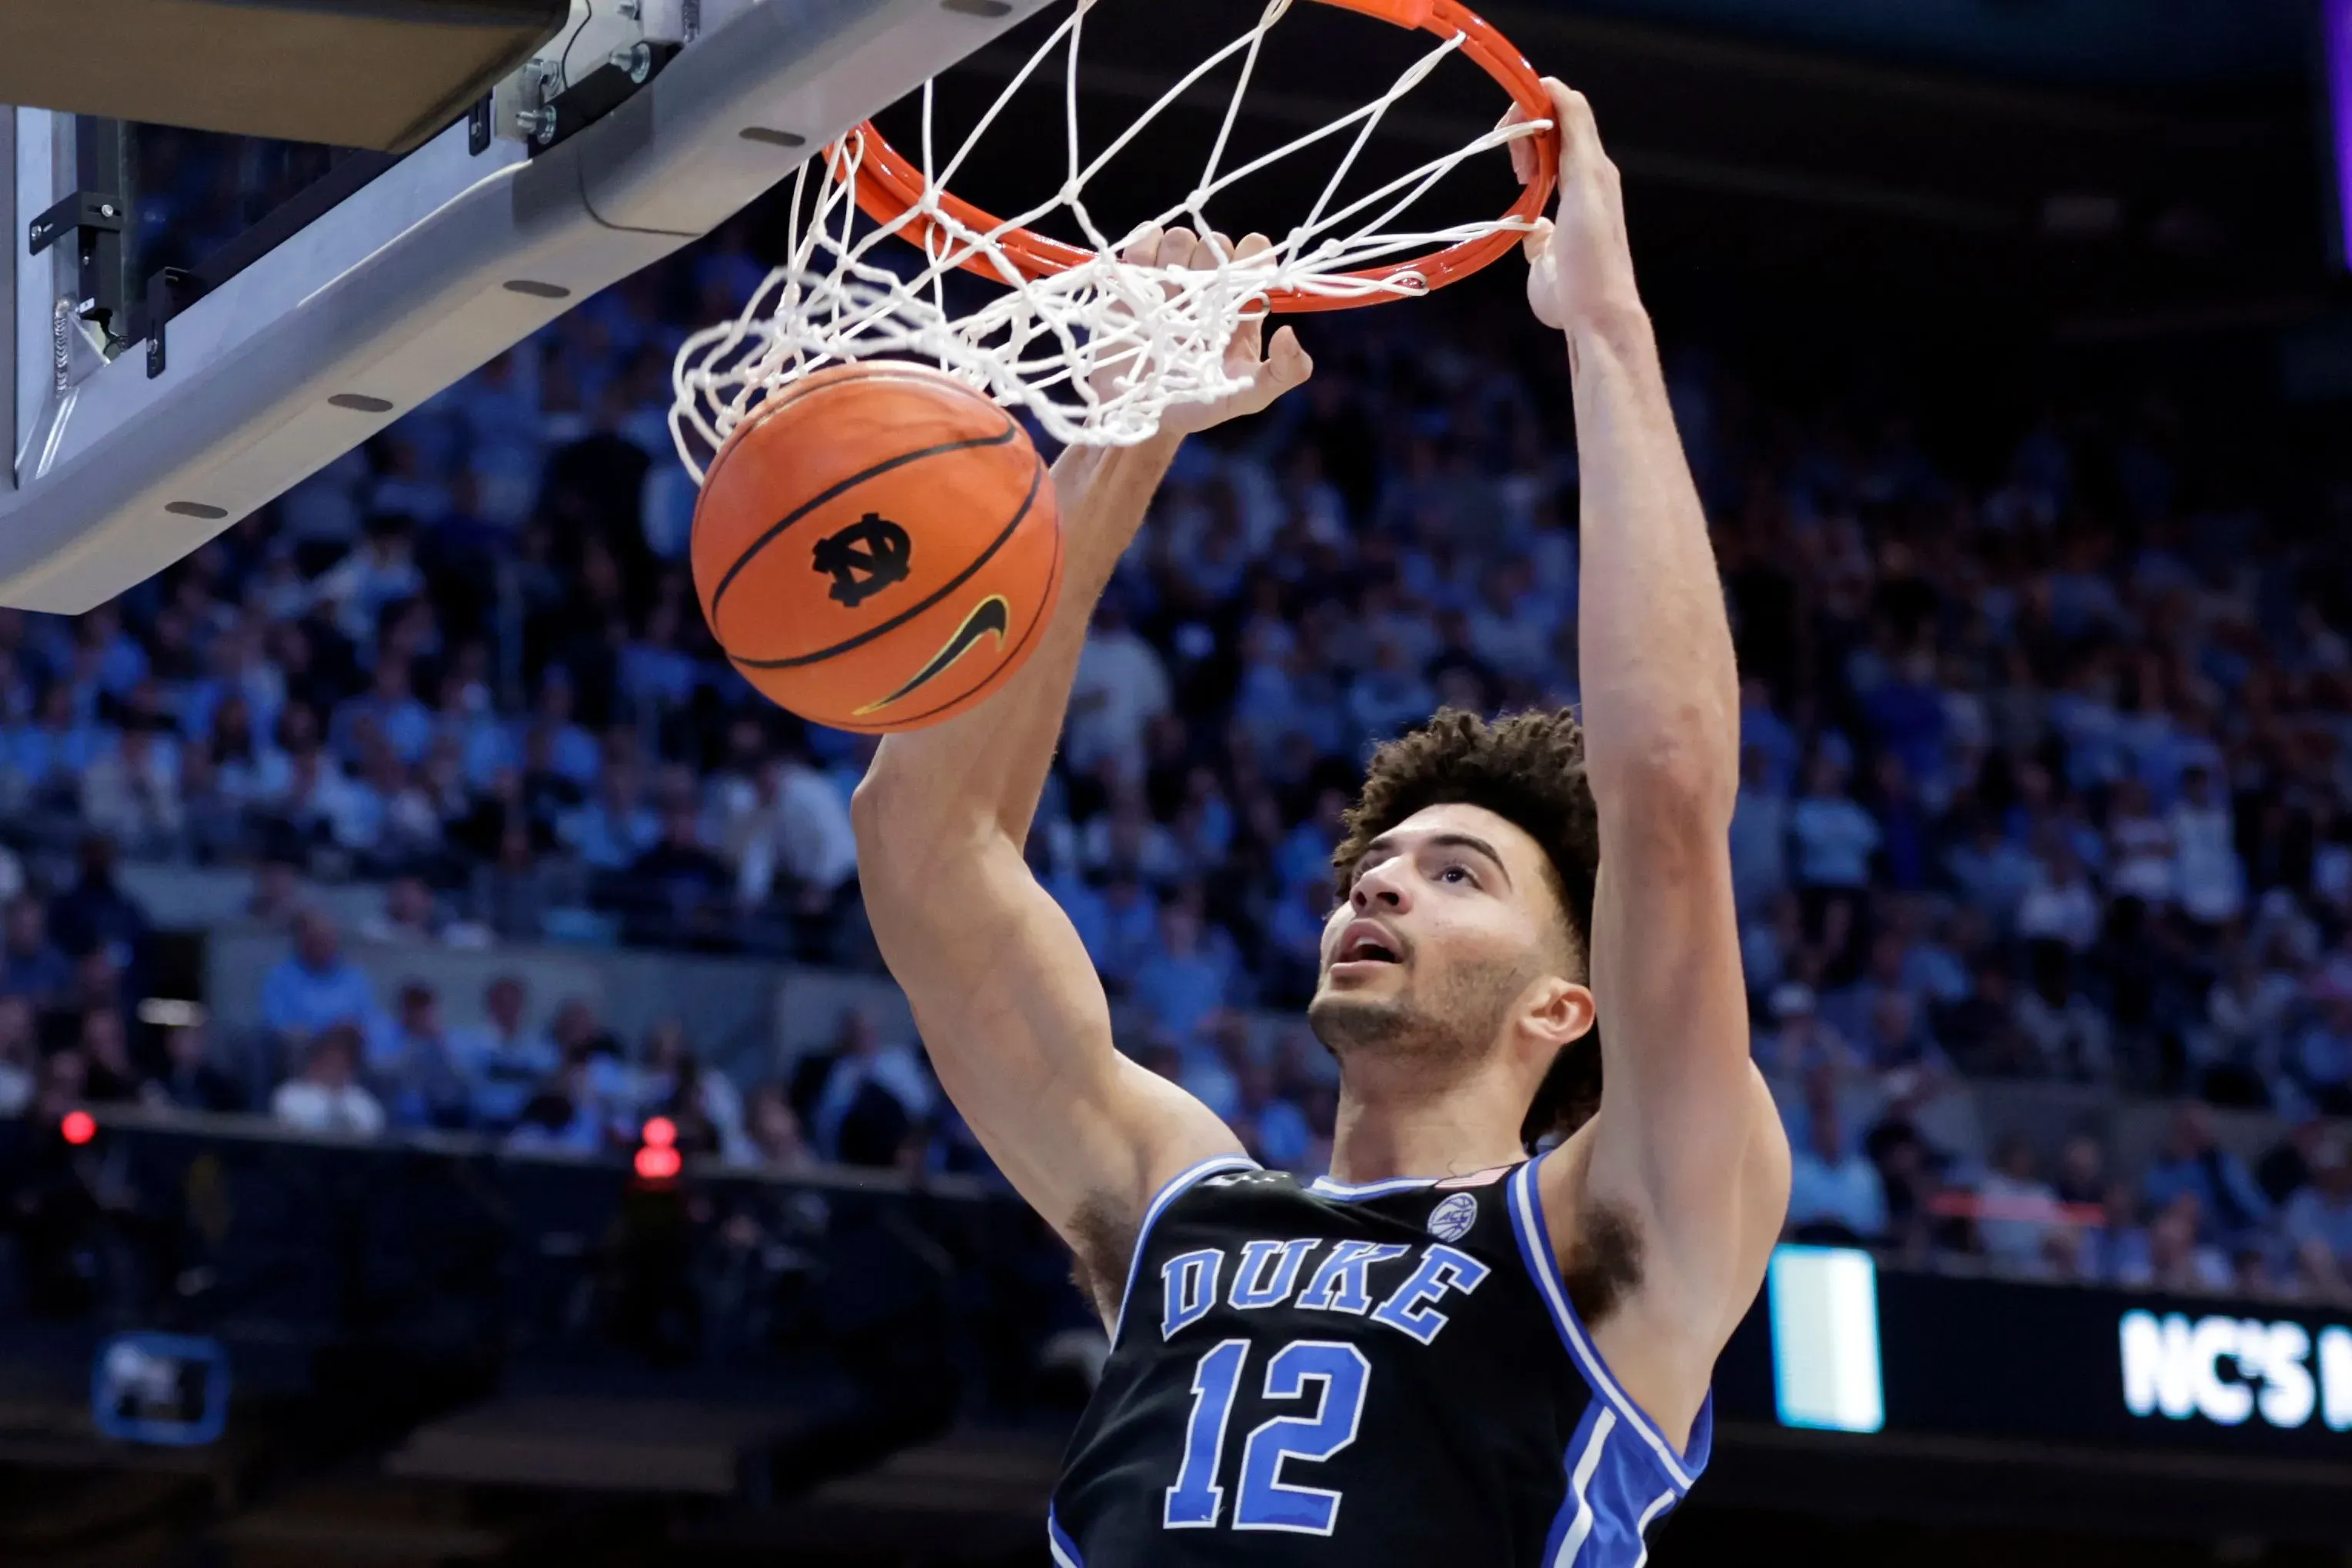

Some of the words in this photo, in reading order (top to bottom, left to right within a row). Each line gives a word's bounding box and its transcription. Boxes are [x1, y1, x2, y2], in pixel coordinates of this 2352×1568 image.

[1161, 1239, 1491, 1346] DUKE
[2120, 1309, 2316, 1429] NC'S
[1163, 1339, 1371, 1536] 12
